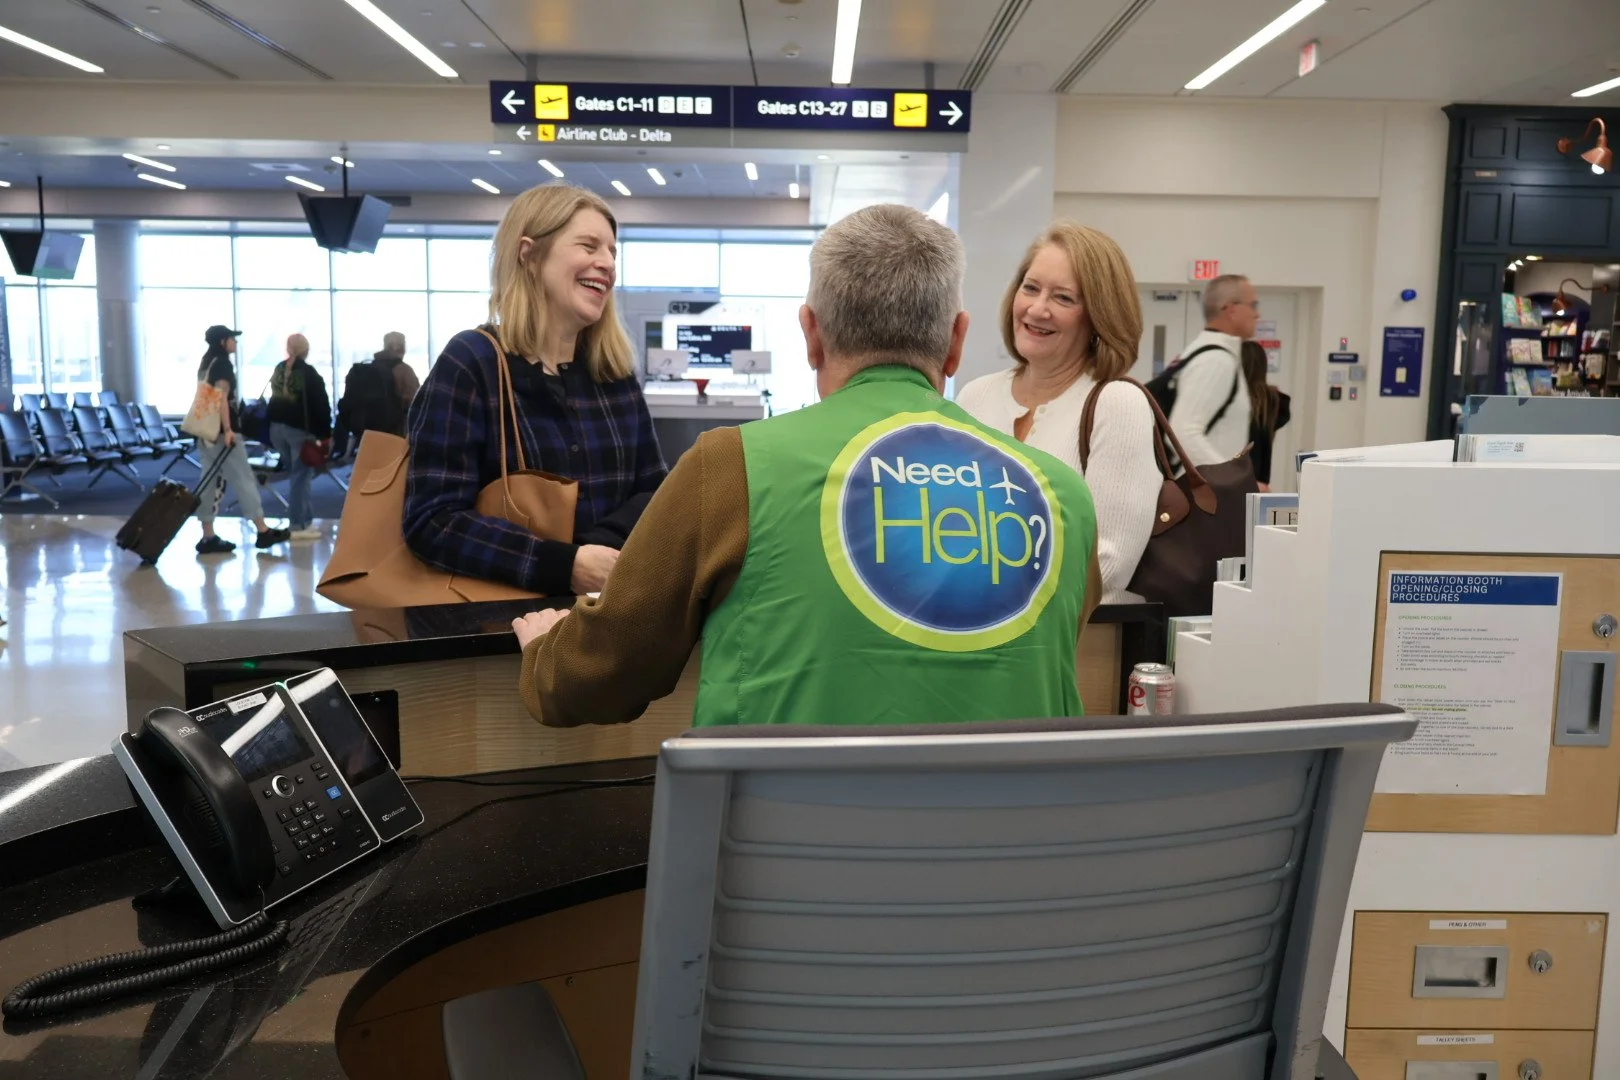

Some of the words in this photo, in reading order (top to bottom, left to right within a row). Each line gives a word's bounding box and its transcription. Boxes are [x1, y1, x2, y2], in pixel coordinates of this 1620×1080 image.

[575, 96, 614, 112] Gates
[616, 97, 654, 112] C1-11
[757, 99, 797, 115] Gates
[799, 101, 848, 116] C13-27
[557, 127, 598, 141] Airline
[599, 128, 628, 142] Club
[639, 129, 672, 142] Delta
[1194, 260, 1219, 279] EXIT
[870, 456, 982, 488] Need
[874, 486, 1047, 585] Help?
[1393, 576, 1464, 585] INFORMATION
[1467, 576, 1503, 585] BOOTH
[1392, 584, 1488, 594] OPENING/CLOSING
[1392, 593, 1460, 602] PROCEDURES
